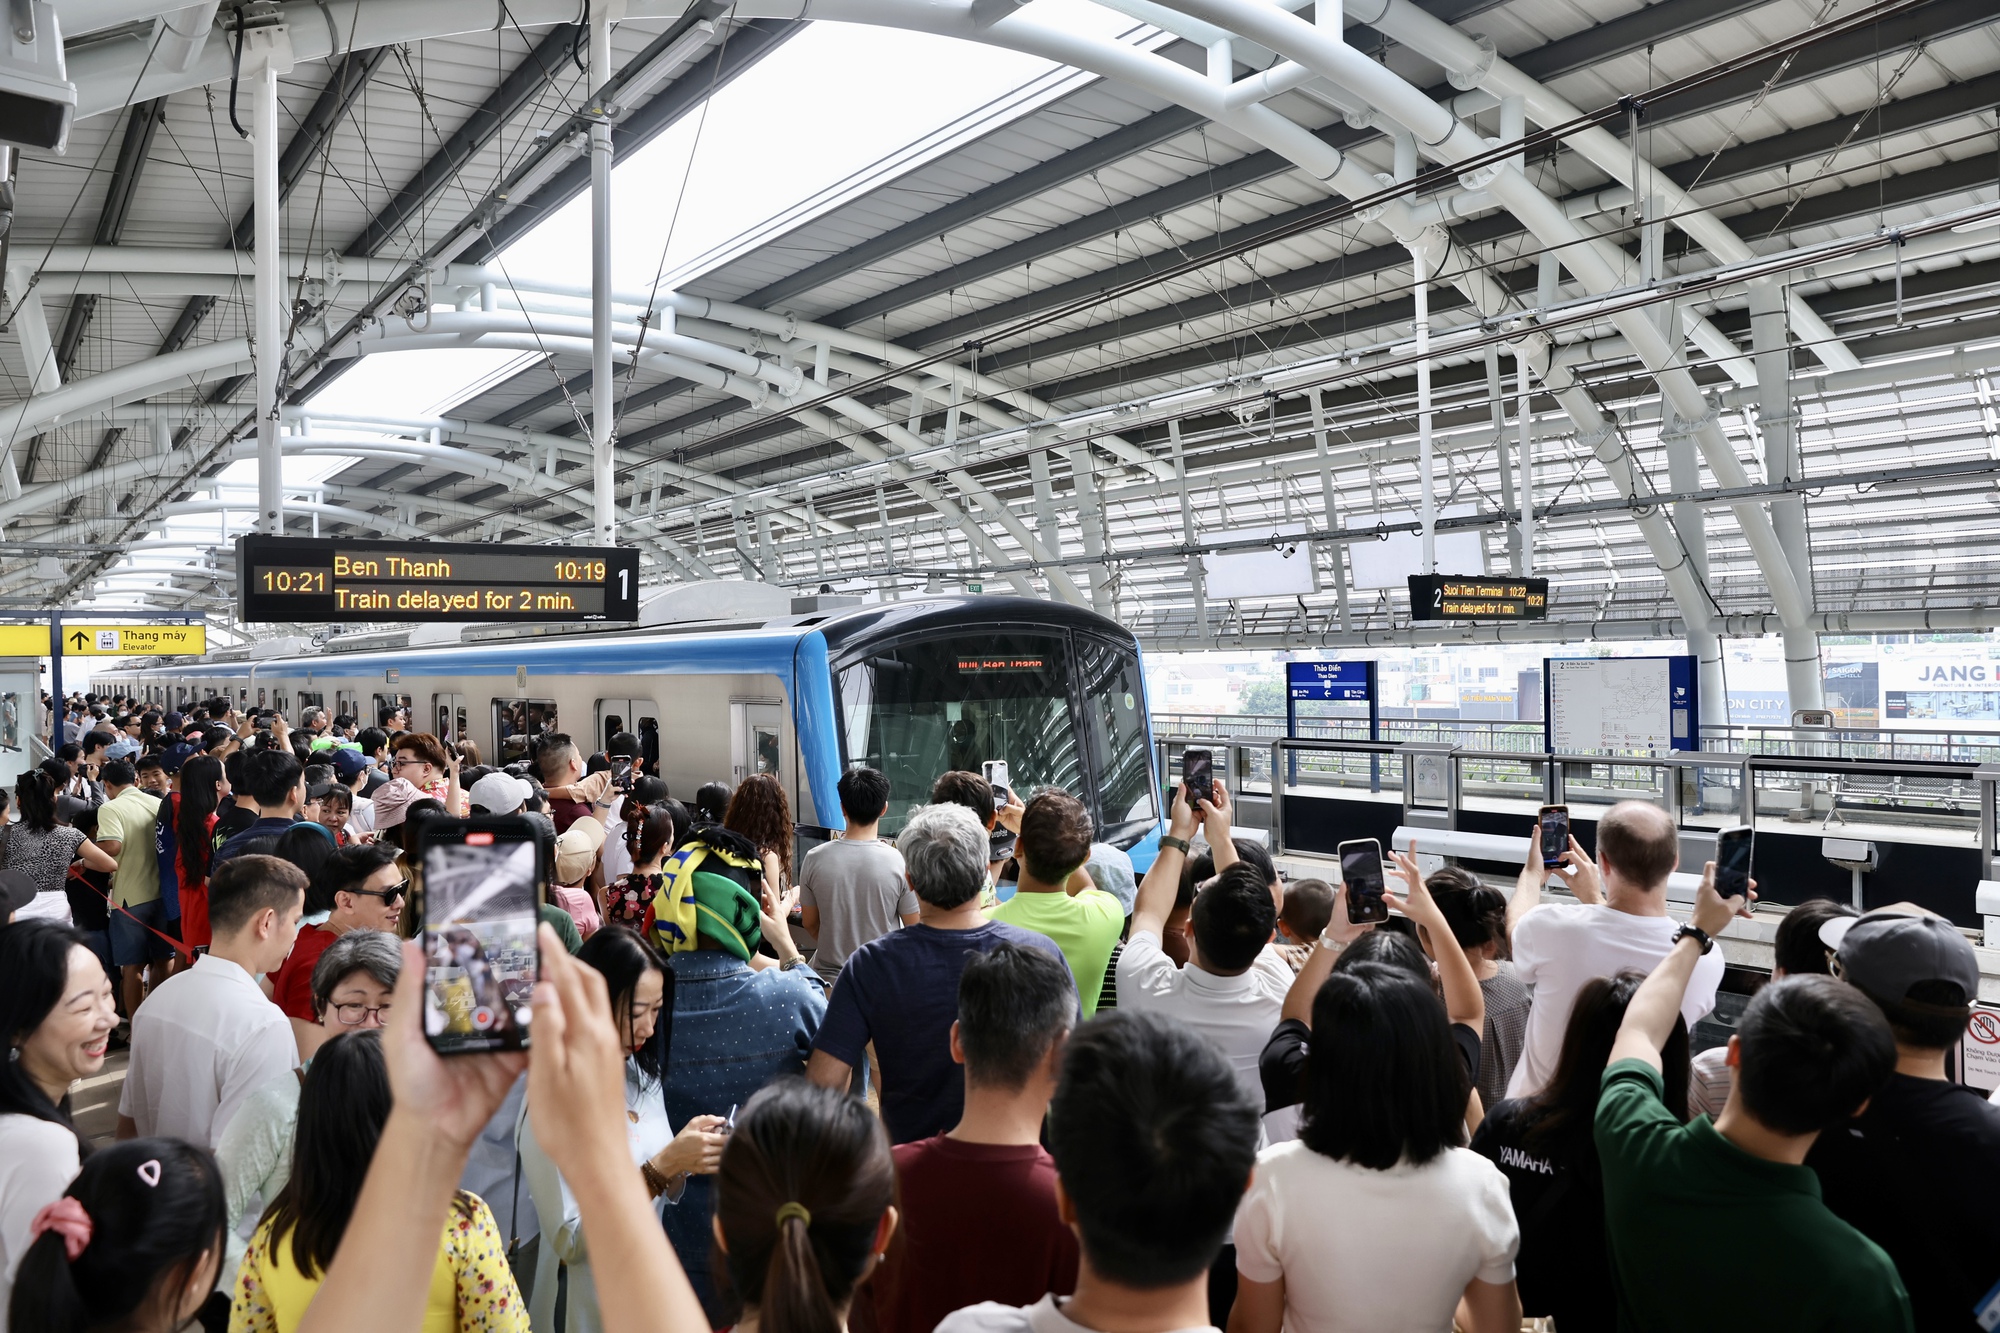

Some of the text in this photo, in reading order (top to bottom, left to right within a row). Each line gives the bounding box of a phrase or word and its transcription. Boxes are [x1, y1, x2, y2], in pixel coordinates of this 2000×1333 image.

[335, 556, 606, 580] Ben Thanh 10:19
[263, 571, 325, 592] 10:21
[618, 569, 629, 600] 1
[1433, 588, 1442, 608] 2
[1444, 585, 1526, 597] Suoi Tien Terminal 10:22
[334, 589, 575, 612] Train delayed for 2 min.
[1442, 602, 1515, 615] Train delayed for 1 min.
[1527, 596, 1543, 606] 10:21
[123, 630, 187, 642] Thang máy
[123, 643, 156, 651] Elevator
[1918, 665, 1986, 681] JANG
[1750, 700, 1785, 710] CITY
[1500, 1145, 1553, 1175] YAMAHA
